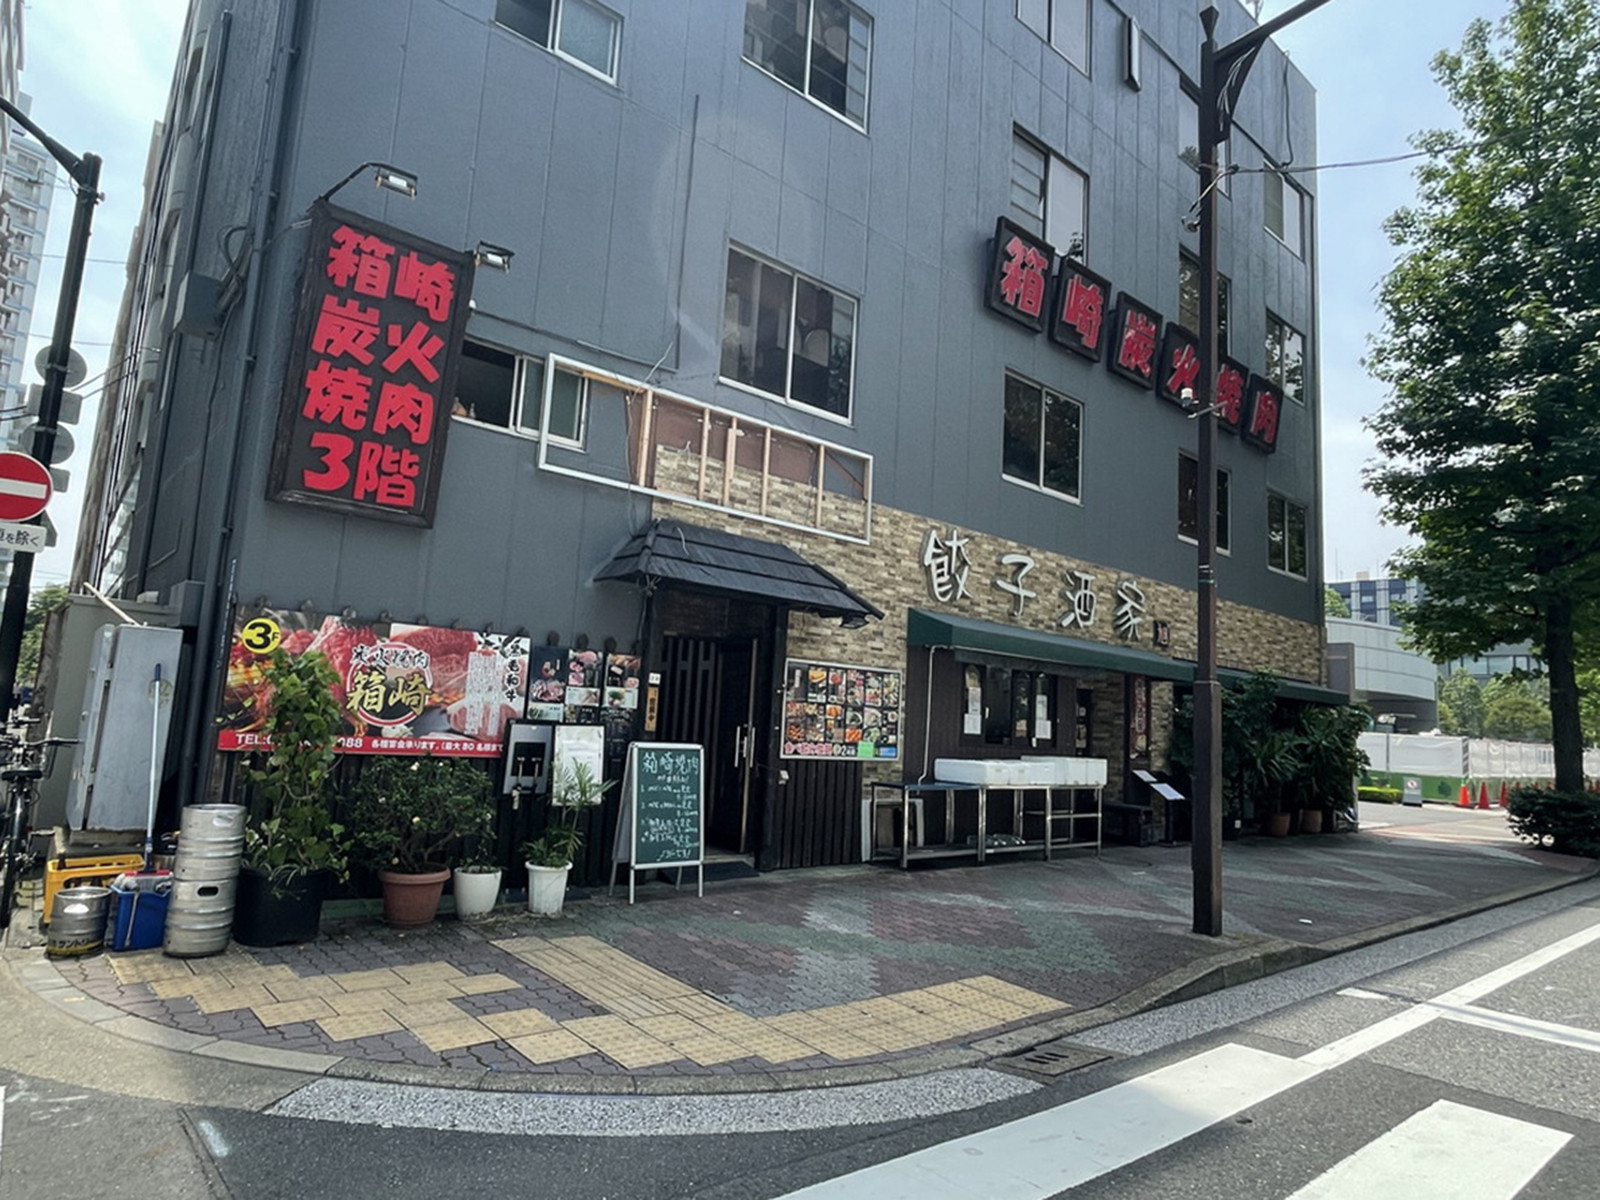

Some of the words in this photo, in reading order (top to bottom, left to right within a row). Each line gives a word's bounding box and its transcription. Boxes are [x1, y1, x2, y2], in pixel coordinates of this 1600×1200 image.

[326, 224, 455, 322] 箱崎
[311, 294, 445, 383] 炭火
[303, 431, 420, 507] 3階
[922, 529, 1146, 641] 餃子酒家
[244, 622, 280, 649] 3F
[346, 670, 432, 715] 箱崎
